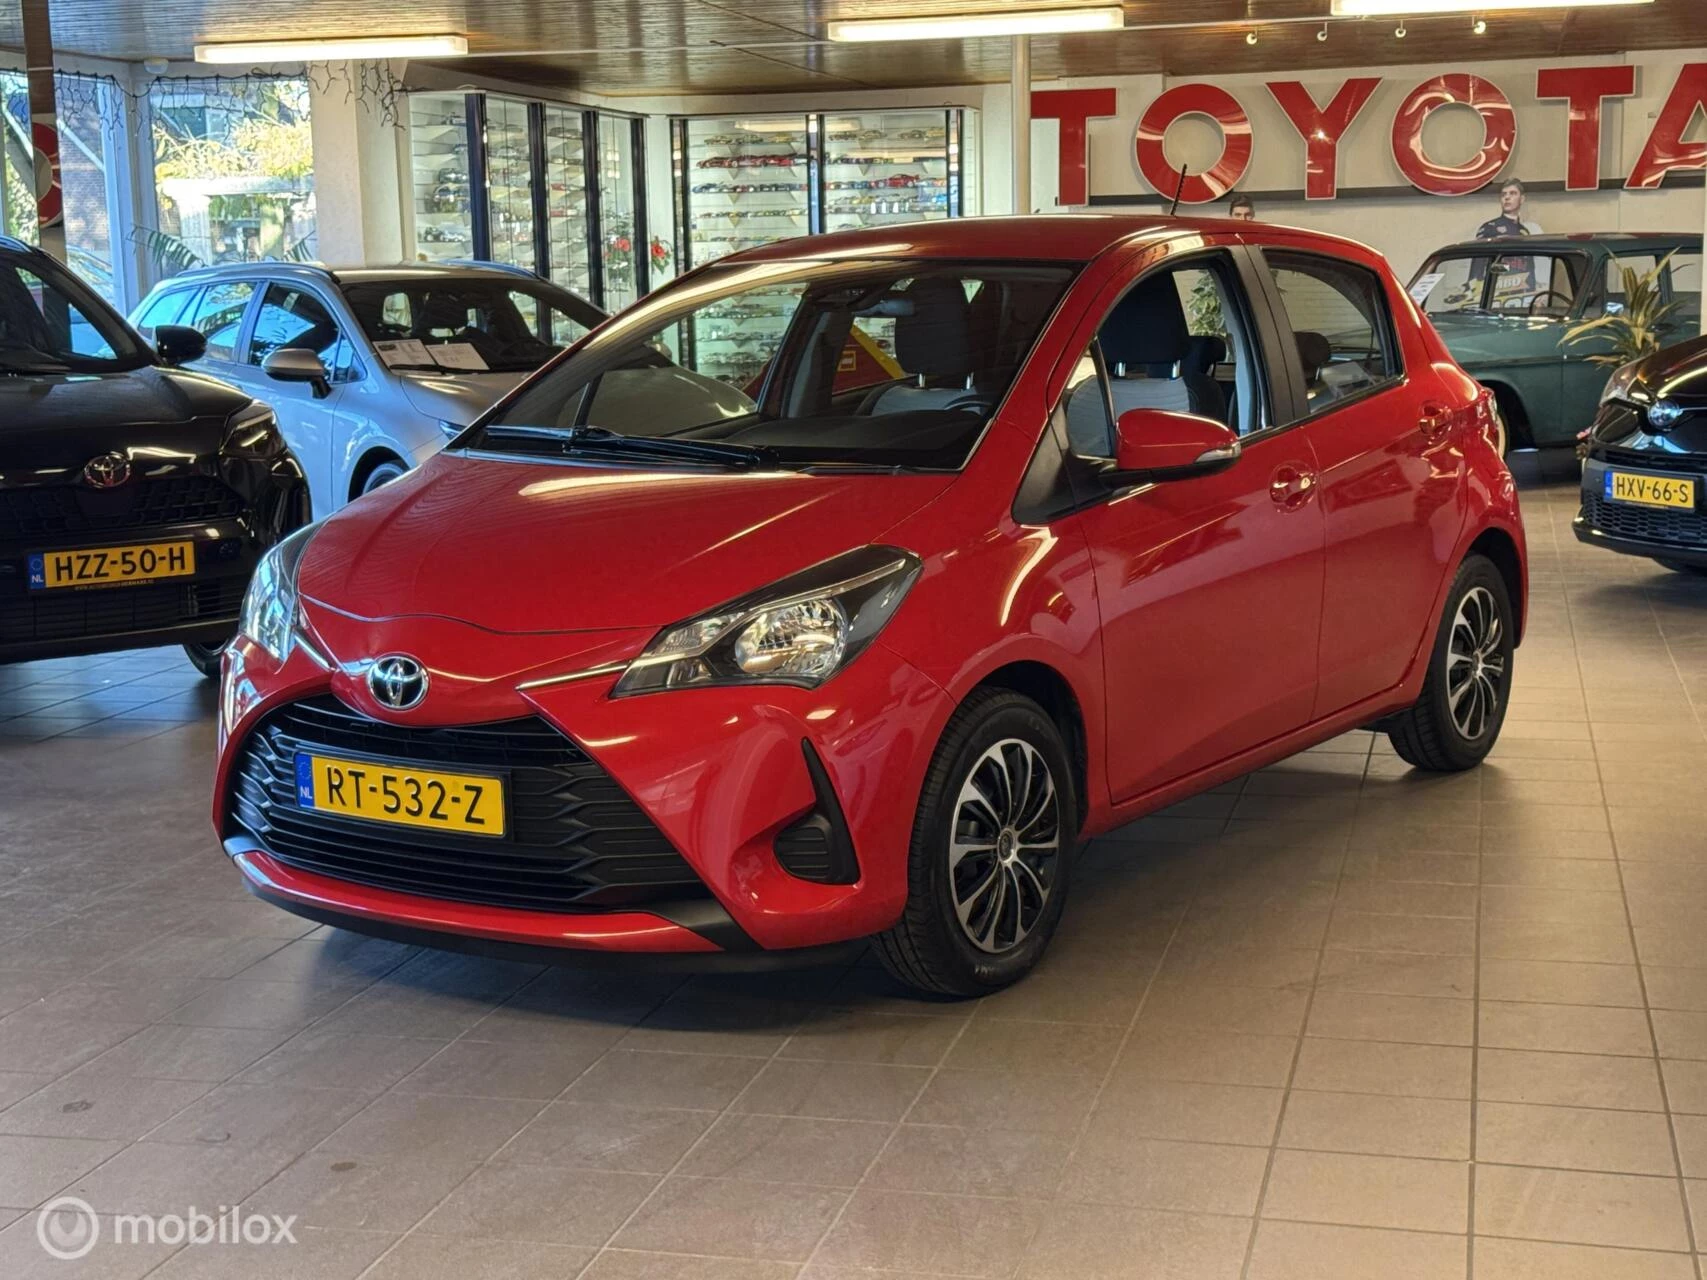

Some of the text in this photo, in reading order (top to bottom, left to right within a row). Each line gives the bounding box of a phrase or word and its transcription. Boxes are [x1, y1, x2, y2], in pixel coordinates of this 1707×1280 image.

[1031, 64, 1707, 206] TOYOTA
[1616, 476, 1689, 503] HXV-66-S
[55, 546, 186, 581] HZZ-50-H
[31, 575, 44, 584] NL
[300, 786, 313, 799] NL
[326, 765, 485, 825] RT-532-Z
